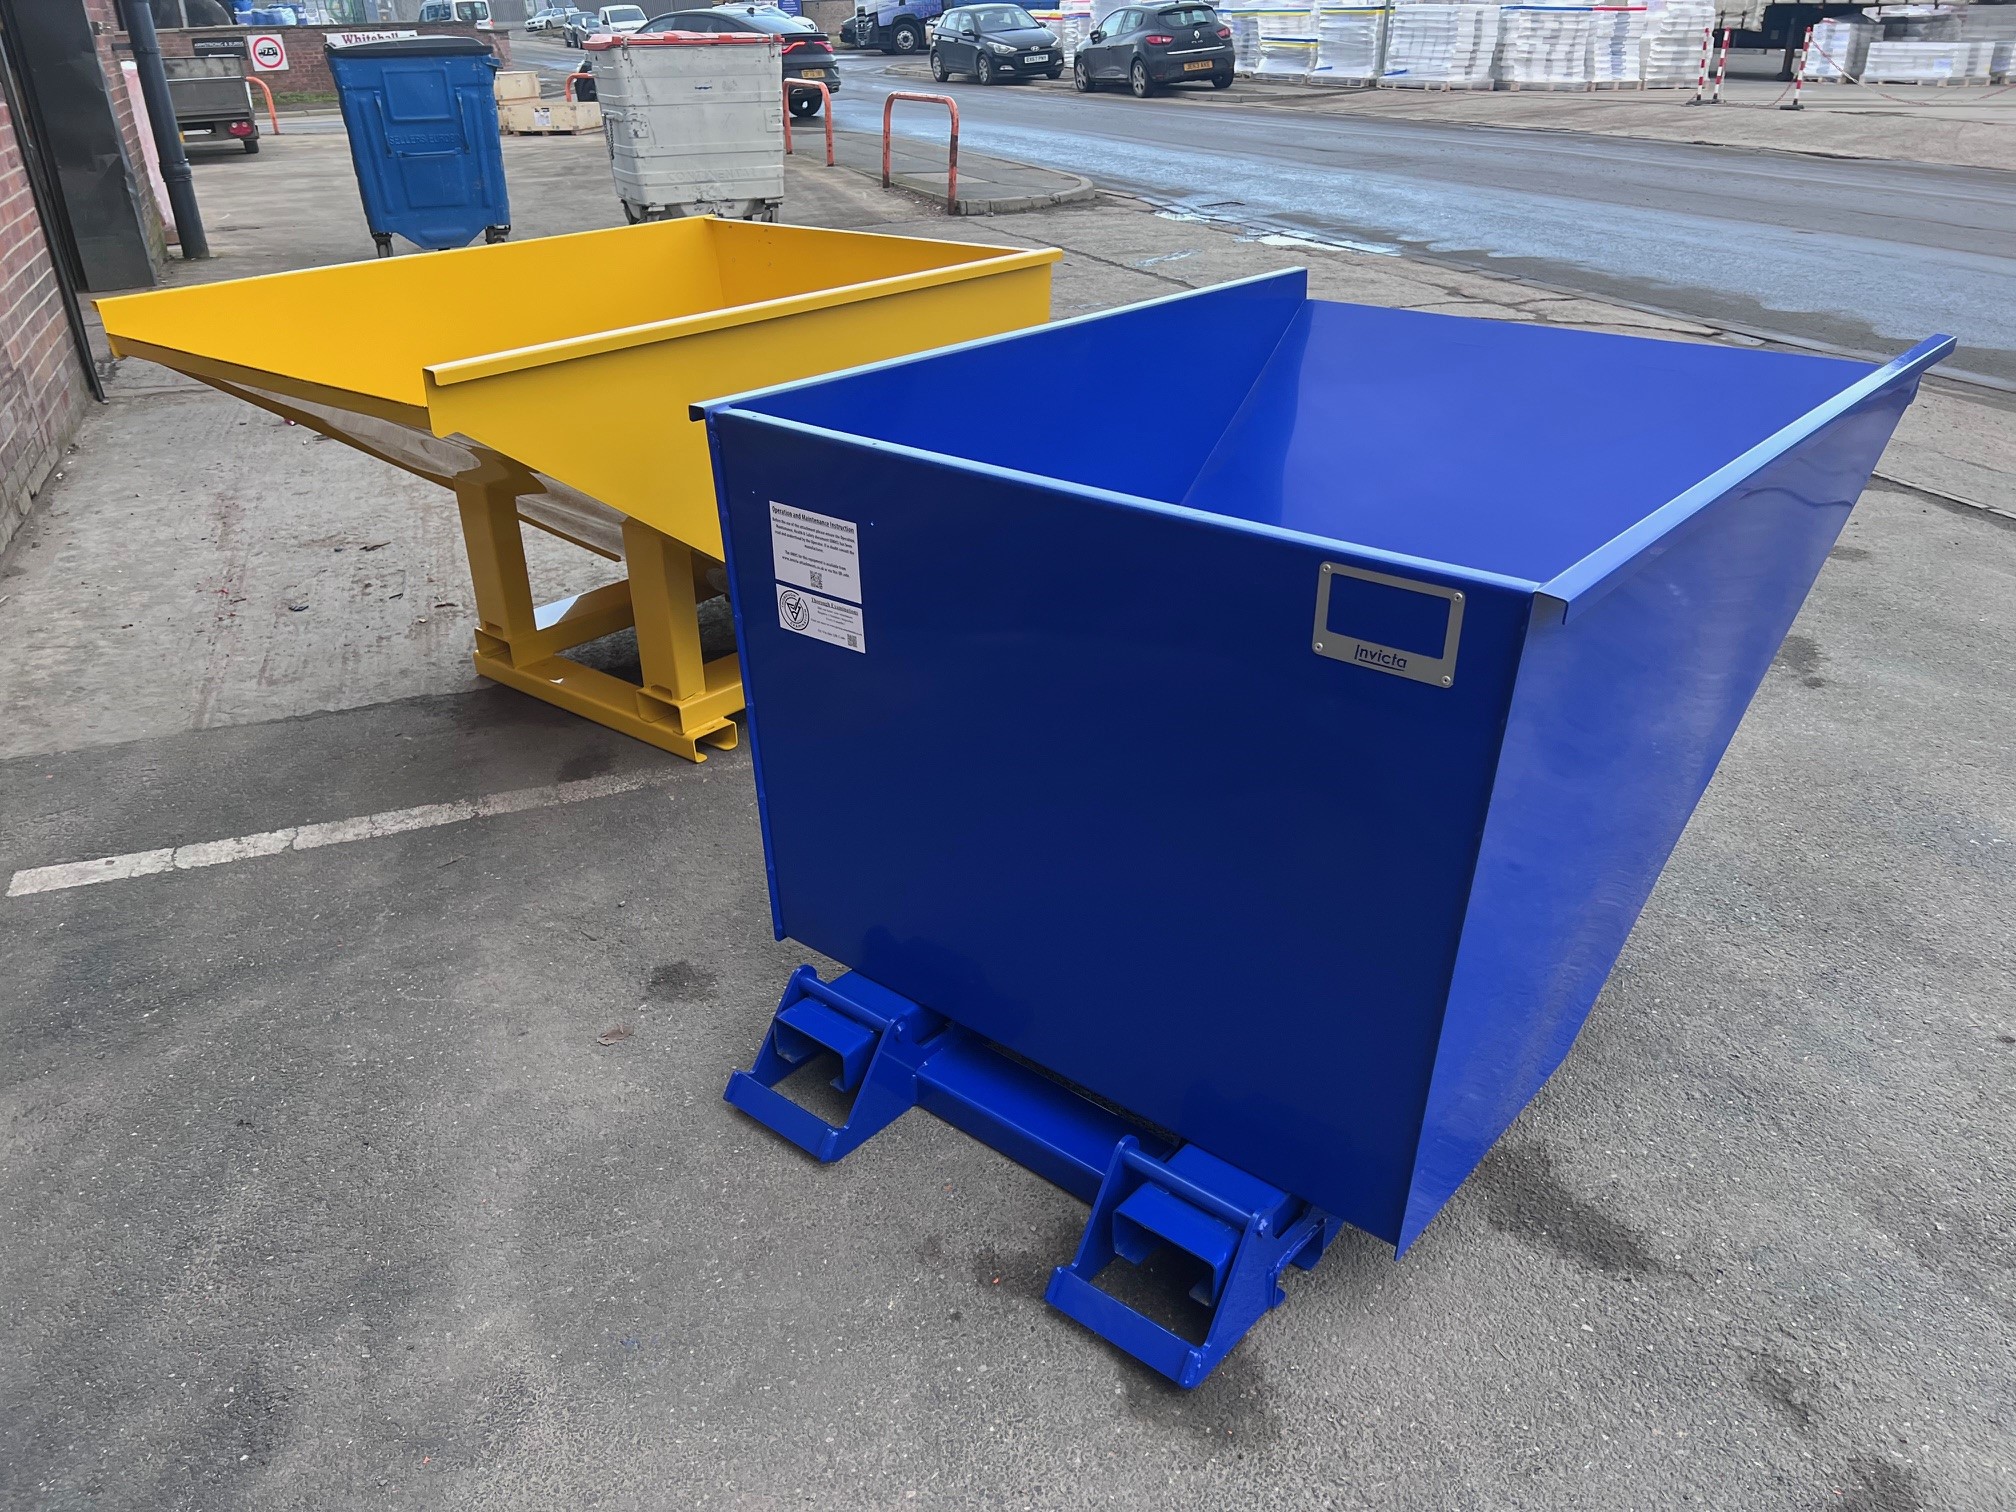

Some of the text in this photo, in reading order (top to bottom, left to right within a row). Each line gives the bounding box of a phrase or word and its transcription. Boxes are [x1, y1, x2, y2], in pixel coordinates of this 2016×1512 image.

[772, 506, 792, 518] Operation
[802, 514, 829, 527] Maintenance
[1353, 644, 1407, 669] Invicta
